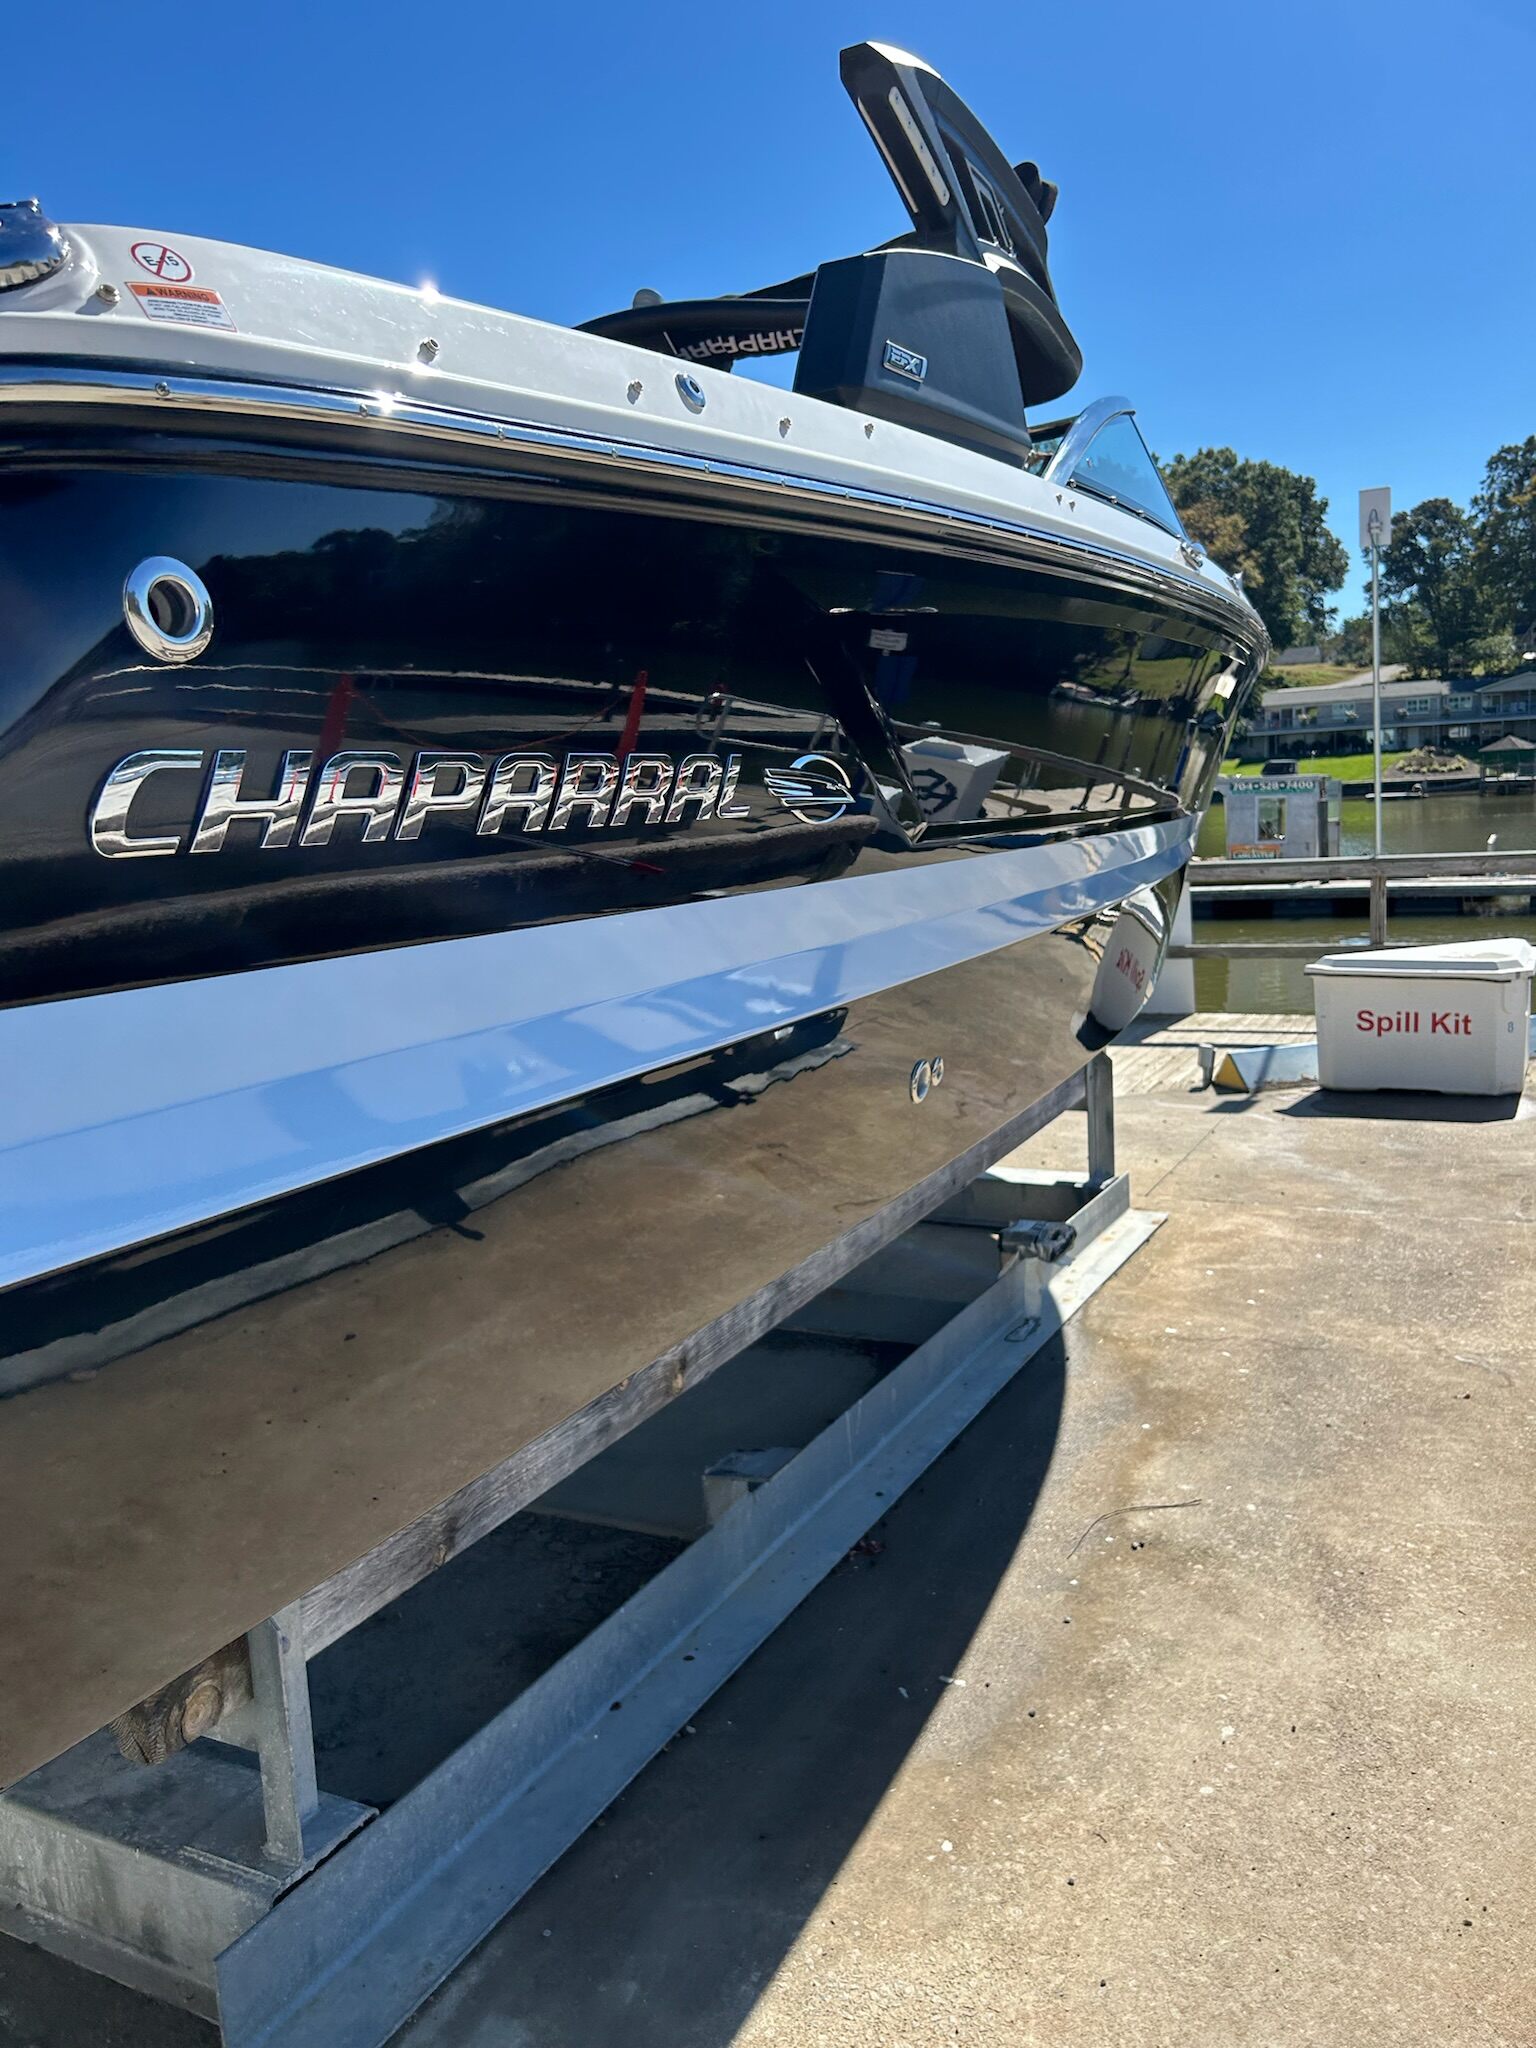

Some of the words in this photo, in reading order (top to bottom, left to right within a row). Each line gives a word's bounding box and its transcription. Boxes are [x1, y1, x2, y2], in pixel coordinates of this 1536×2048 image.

[159, 288, 210, 302] WARNING
[91, 749, 751, 859] CHAPARRAL
[1356, 1009, 1420, 1038] Spill
[1431, 1011, 1473, 1036] Kit
